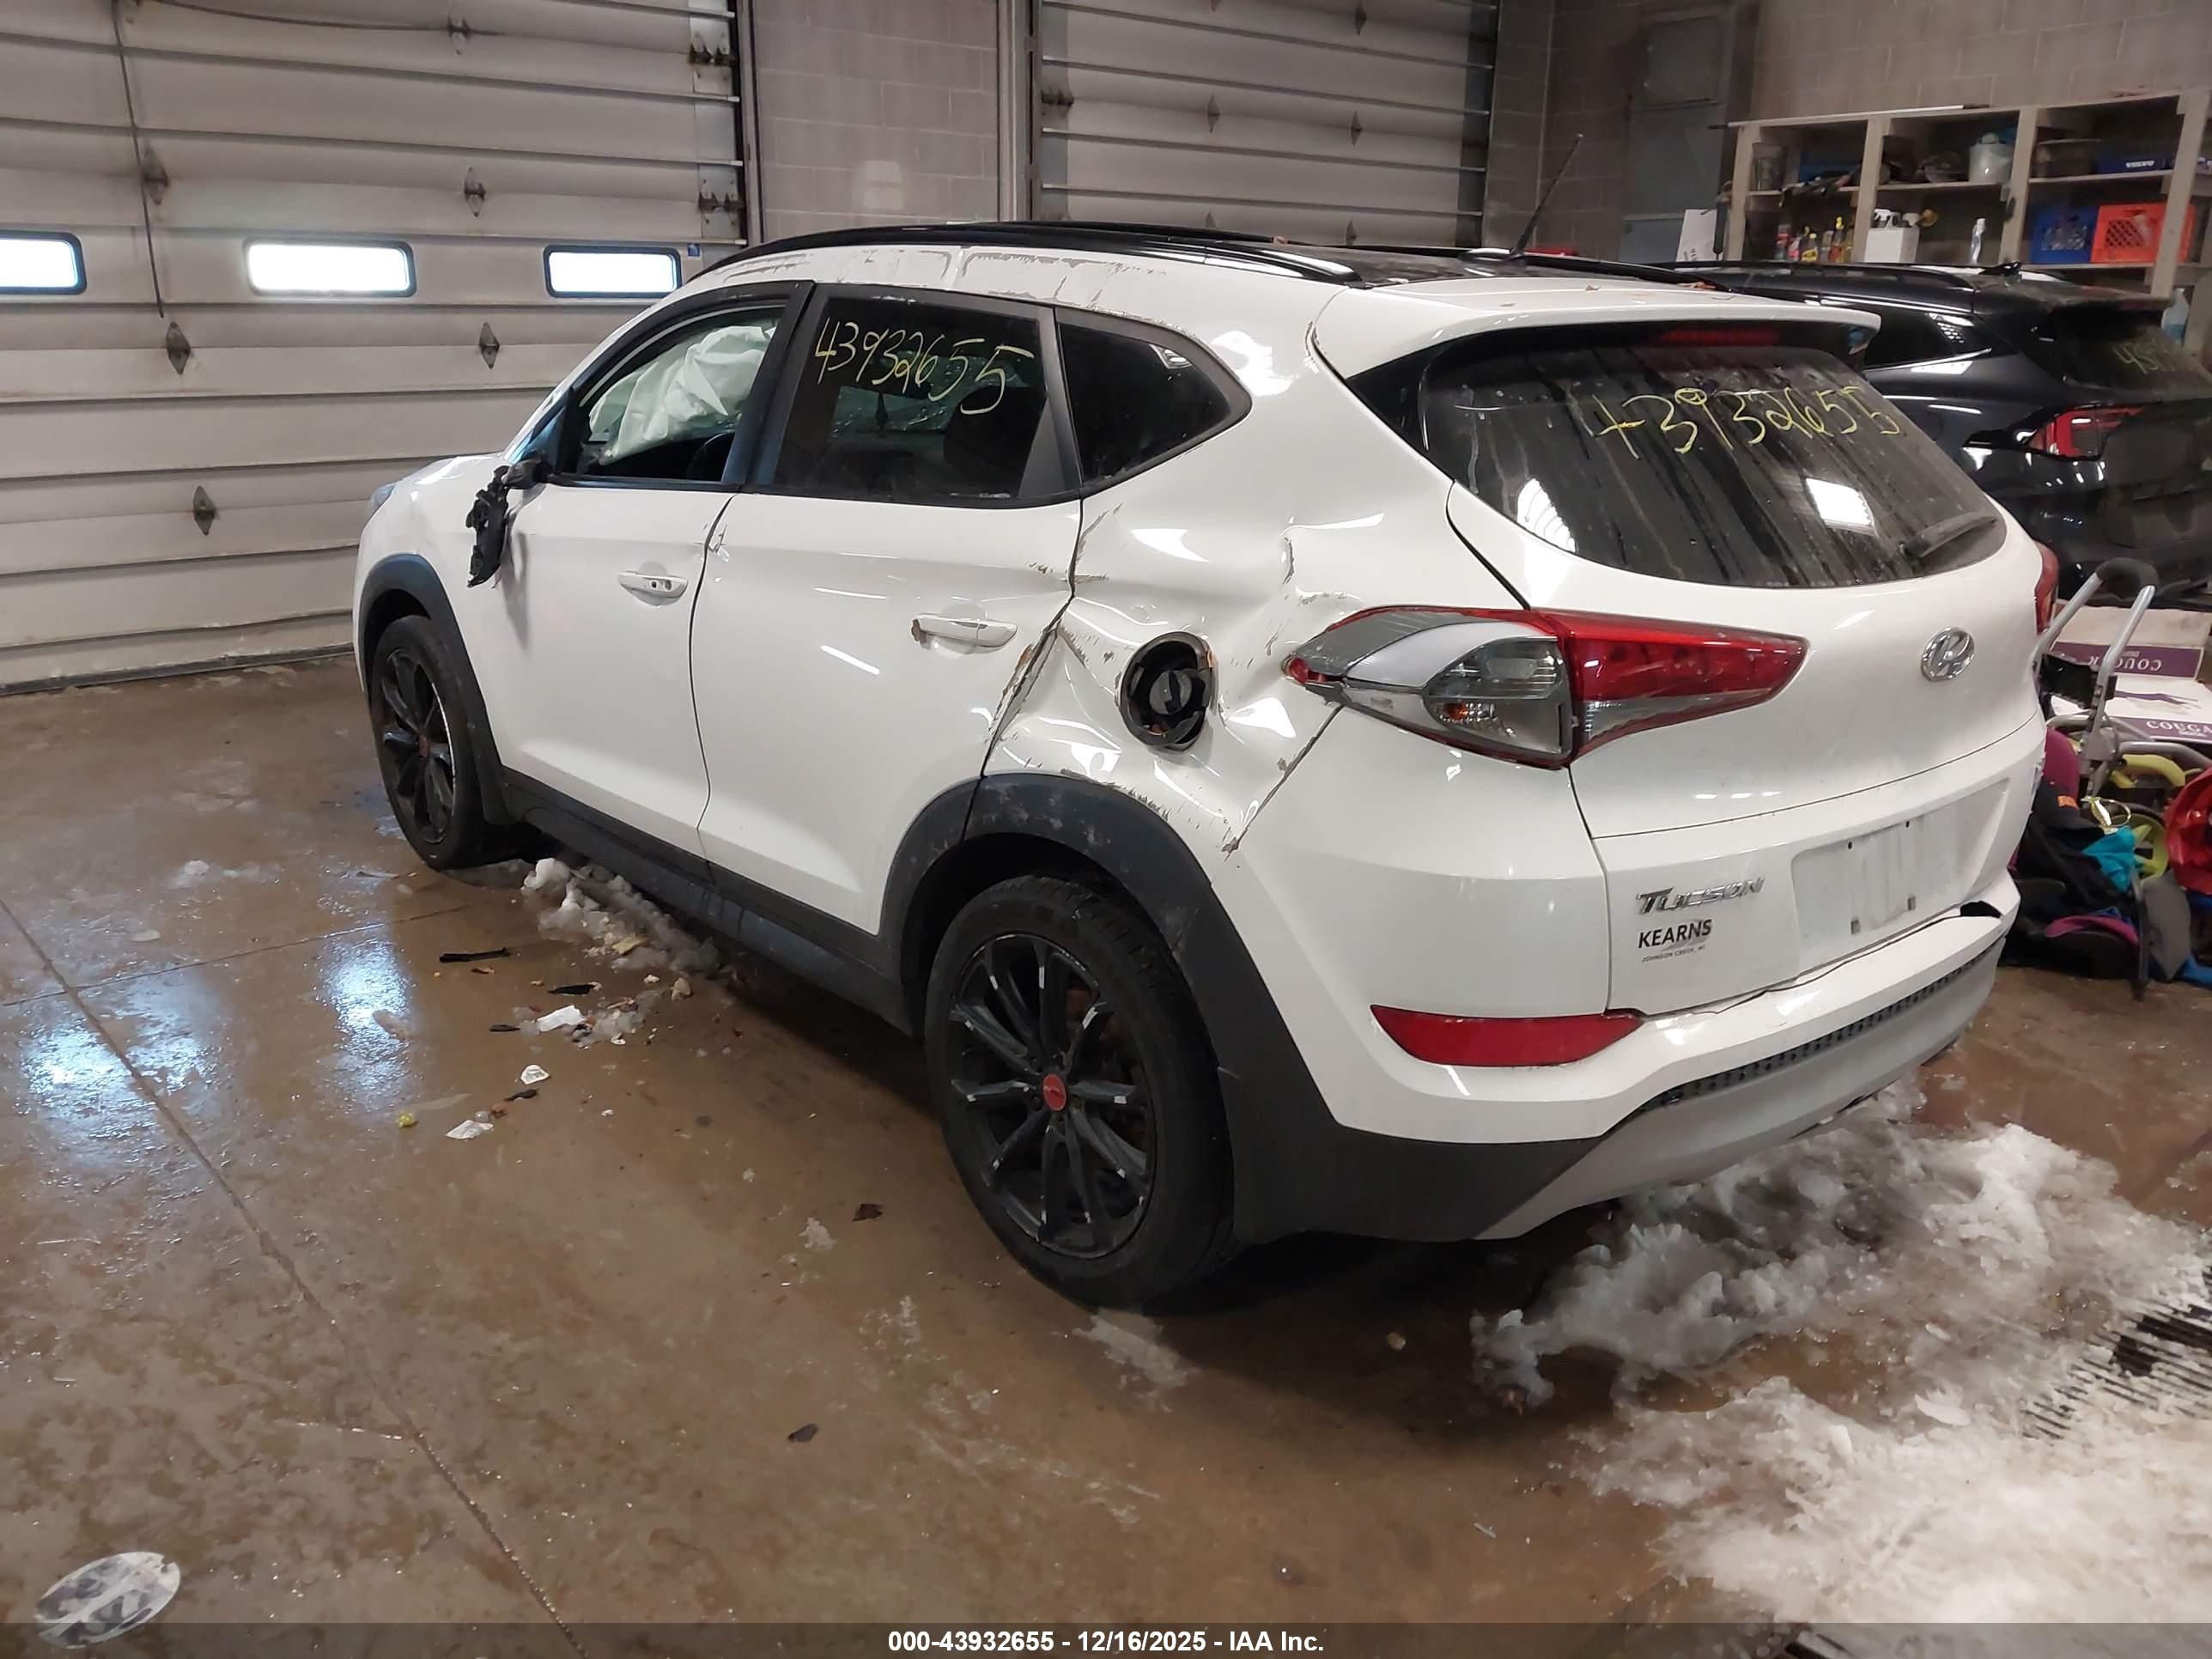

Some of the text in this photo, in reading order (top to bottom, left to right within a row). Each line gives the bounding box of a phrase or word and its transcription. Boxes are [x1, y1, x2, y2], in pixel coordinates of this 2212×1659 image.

[815, 317, 1034, 415] 43932655
[1593, 386, 1901, 459] 43932655
[1638, 919, 1712, 948] KEARNS
